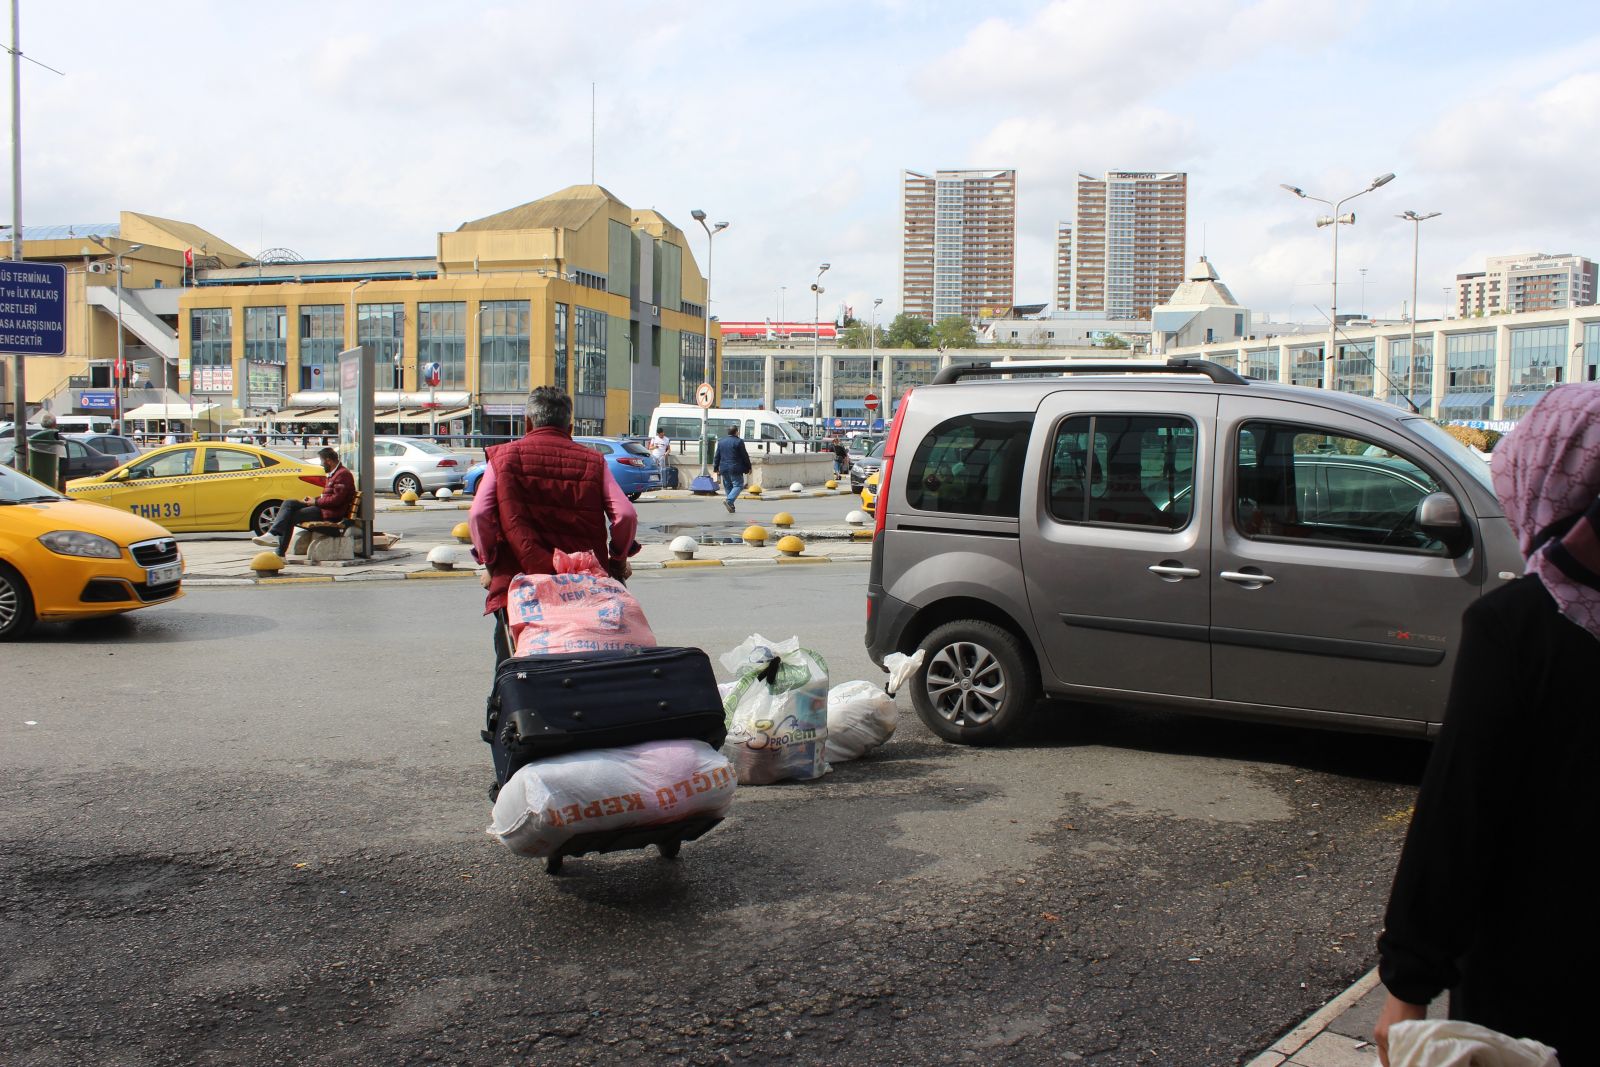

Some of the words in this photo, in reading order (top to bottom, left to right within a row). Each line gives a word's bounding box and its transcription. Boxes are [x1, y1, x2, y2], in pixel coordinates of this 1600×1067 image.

[0, 269, 11, 281] ÜS
[13, 271, 52, 284] TERMİNAL
[17, 286, 29, 299] İLK
[31, 289, 59, 302] KALKIŞ
[16, 320, 62, 332] KARŞISINDA
[130, 503, 160, 518] THH
[163, 502, 180, 517] 39
[559, 590, 586, 602] YEM
[656, 763, 737, 811] ÜÇLÜ
